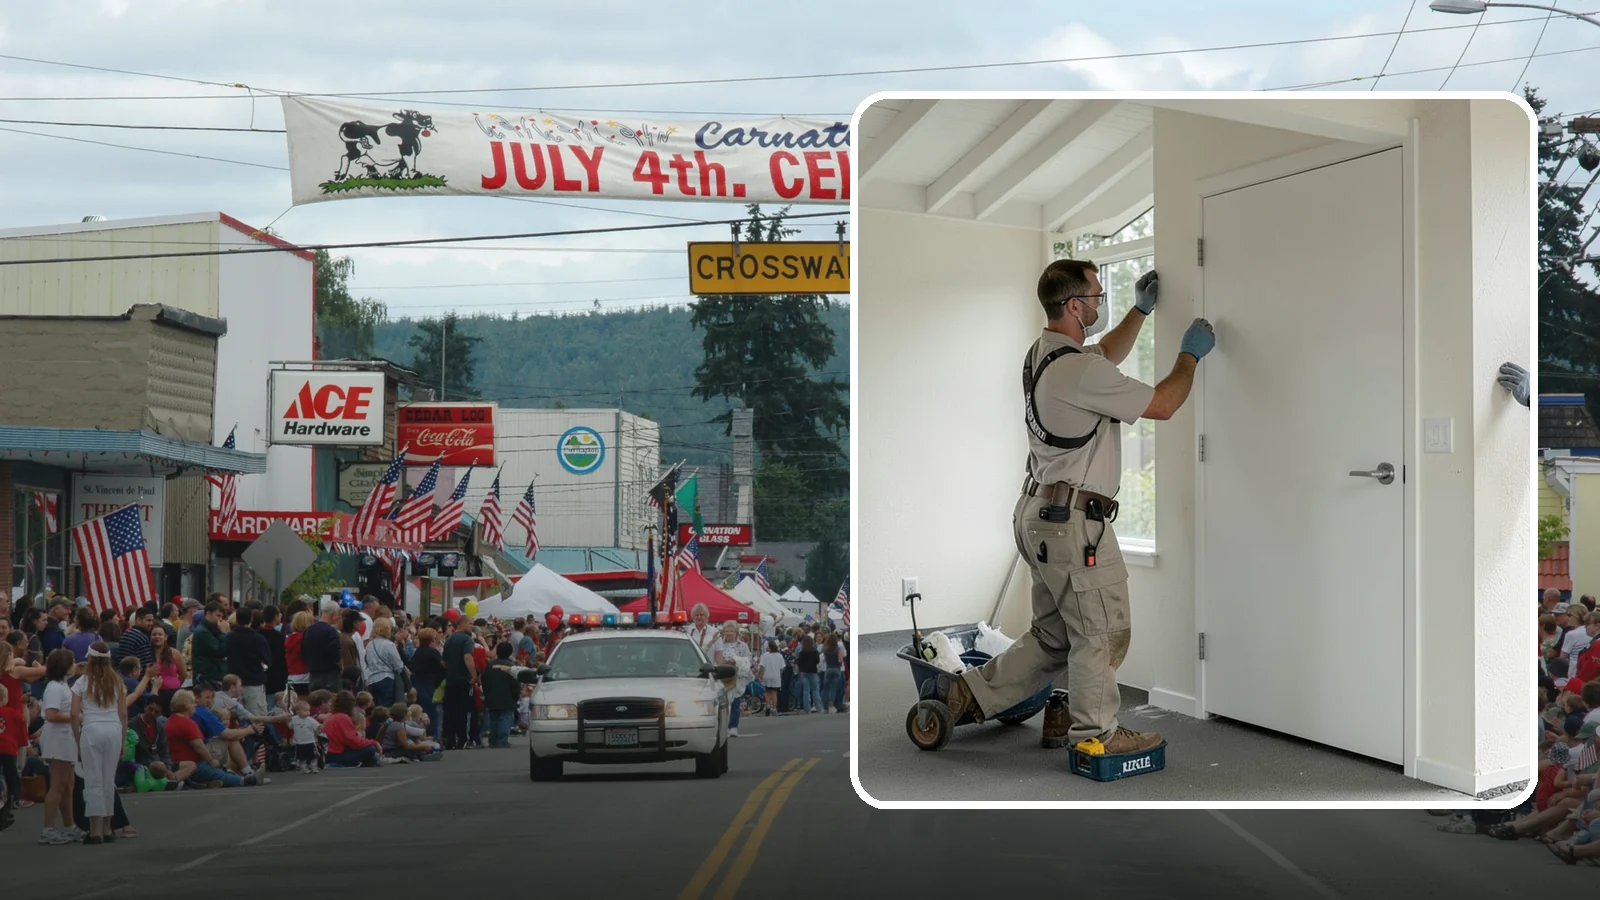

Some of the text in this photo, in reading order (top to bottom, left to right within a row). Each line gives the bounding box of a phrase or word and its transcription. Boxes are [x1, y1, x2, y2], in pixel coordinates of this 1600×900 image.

[481, 141, 604, 192] JULY
[632, 150, 746, 198] 4th.
[697, 254, 850, 280] CROSSWA
[283, 380, 373, 420] ACE
[405, 409, 452, 421] CEDAR
[283, 421, 371, 436] Hardware
[416, 428, 477, 447] Coca-Cola
[353, 467, 384, 479] Simpl
[83, 484, 155, 495] St. Vincent de Paul
[688, 526, 741, 535] CRNATION
[699, 535, 730, 543] GLASS
